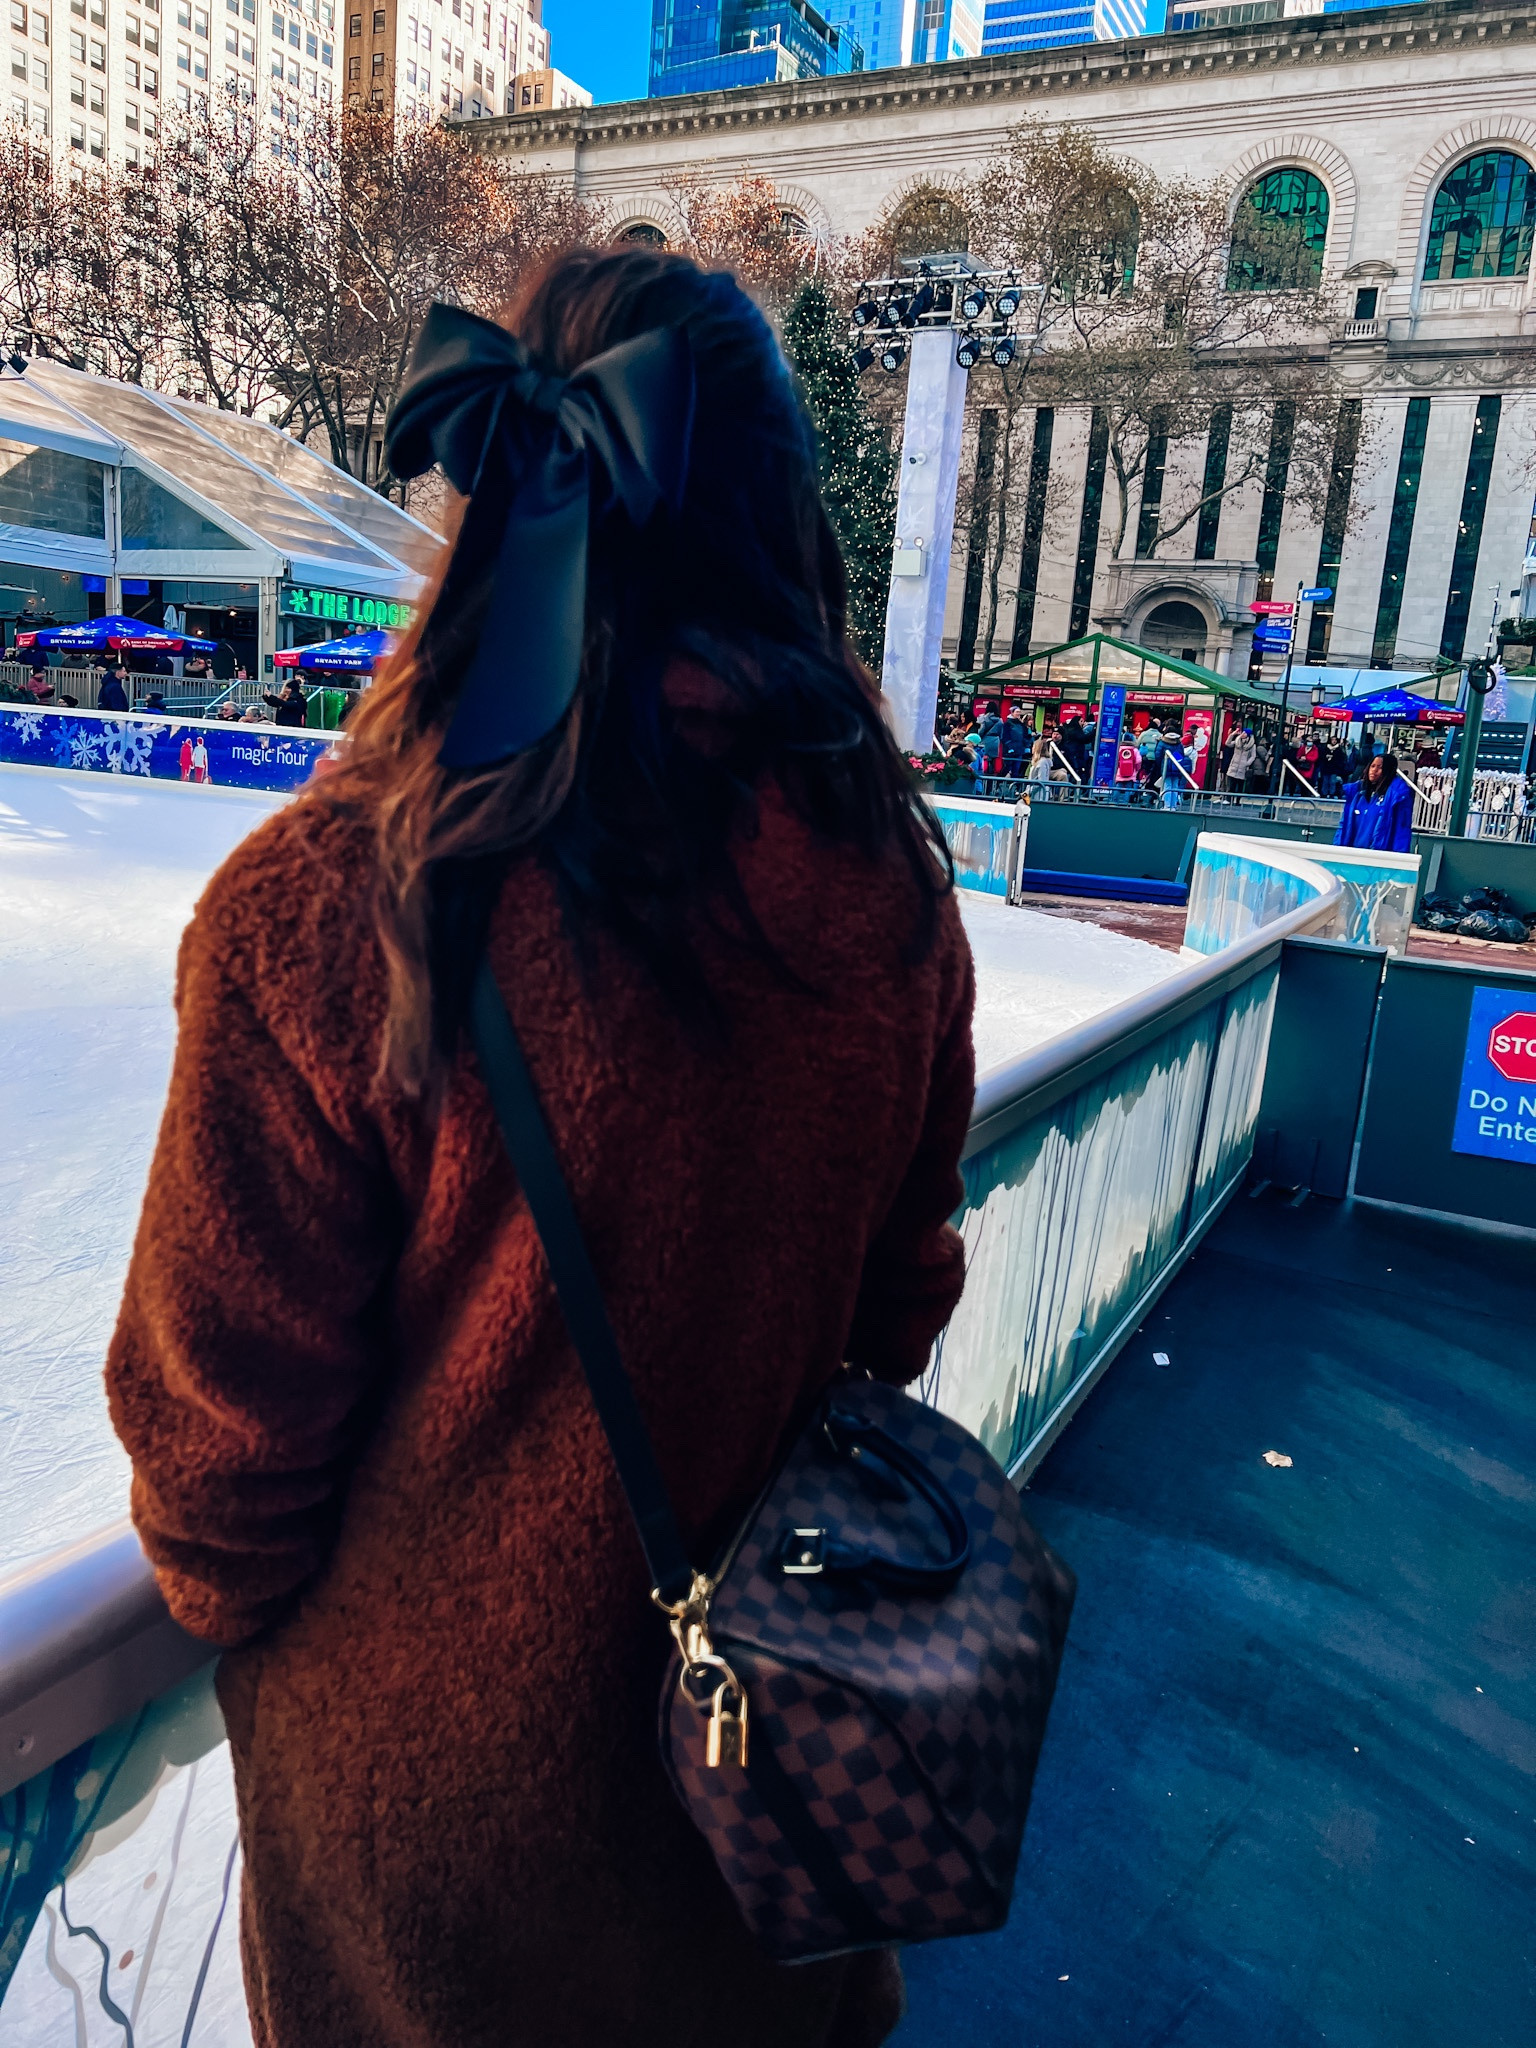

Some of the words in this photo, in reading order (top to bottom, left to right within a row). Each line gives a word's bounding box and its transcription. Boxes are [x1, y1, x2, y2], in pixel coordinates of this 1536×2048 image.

[309, 590, 349, 620] THE
[353, 597, 411, 629] LODGE
[314, 657, 342, 665] BRYANT
[232, 746, 272, 766] magic
[276, 746, 308, 766] hour
[1469, 1089, 1508, 1112] Do
